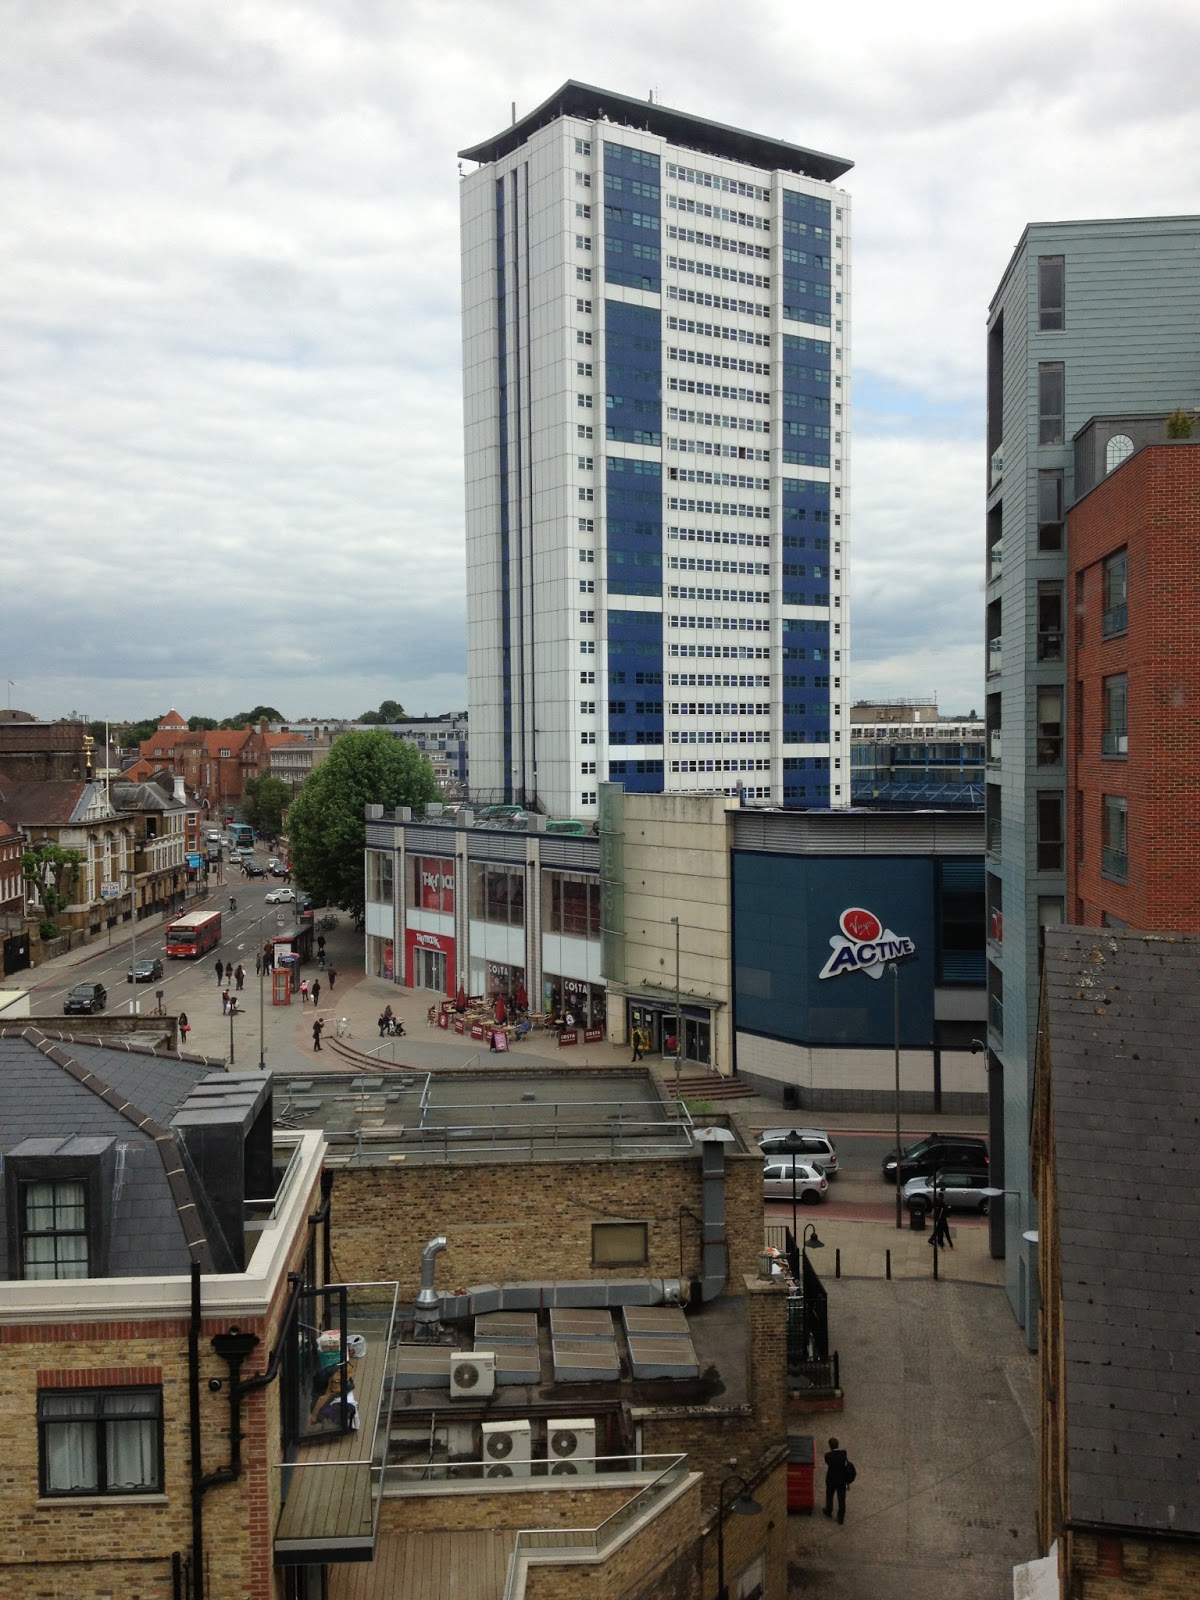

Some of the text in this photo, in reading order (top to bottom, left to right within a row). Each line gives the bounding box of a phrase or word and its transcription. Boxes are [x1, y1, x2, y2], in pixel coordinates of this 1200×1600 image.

[849, 915, 874, 936] Virgin
[828, 939, 912, 972] ACTIVE
[489, 964, 509, 976] COSTA
[564, 980, 588, 994] COSTA
